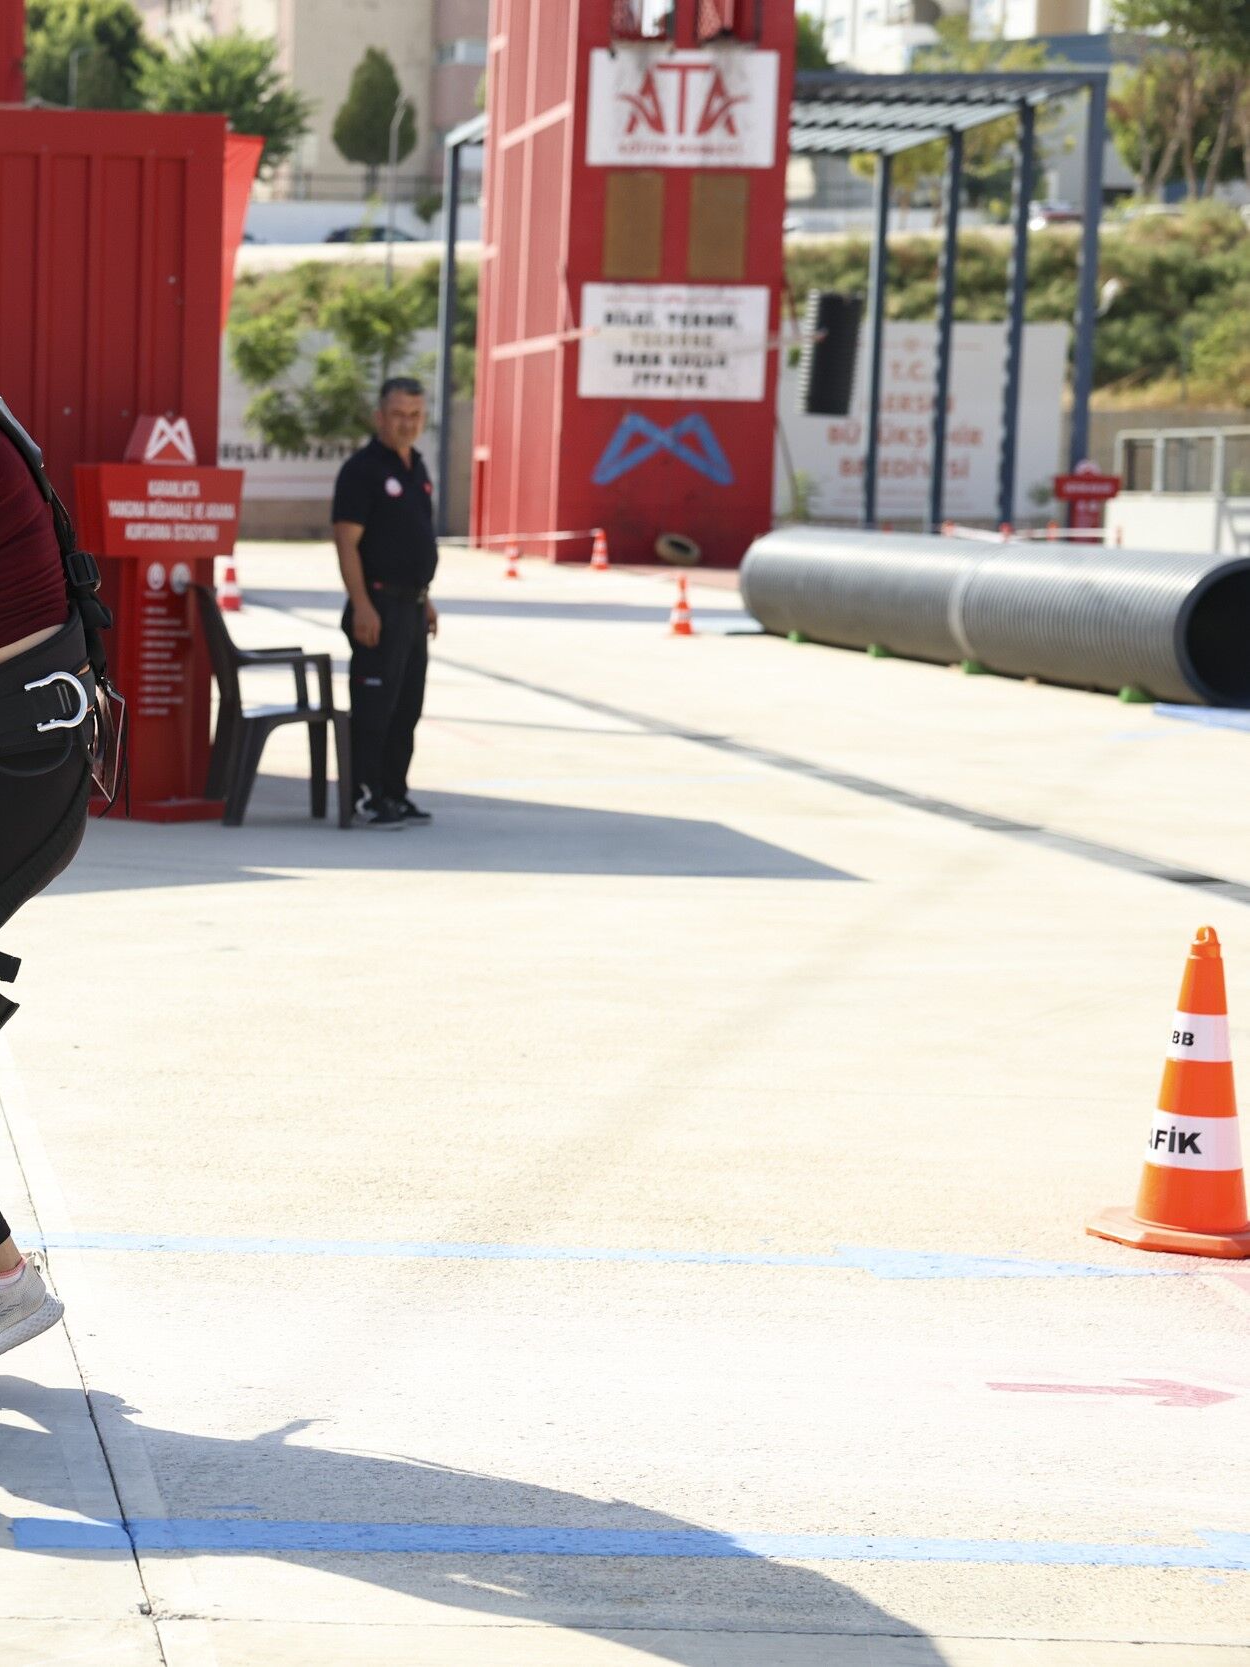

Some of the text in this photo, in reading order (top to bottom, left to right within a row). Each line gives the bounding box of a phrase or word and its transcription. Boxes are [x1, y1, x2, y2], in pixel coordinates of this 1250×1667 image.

[616, 63, 750, 136] ATA
[1172, 1030, 1194, 1046] BB
[1148, 1126, 1202, 1154] FİK
